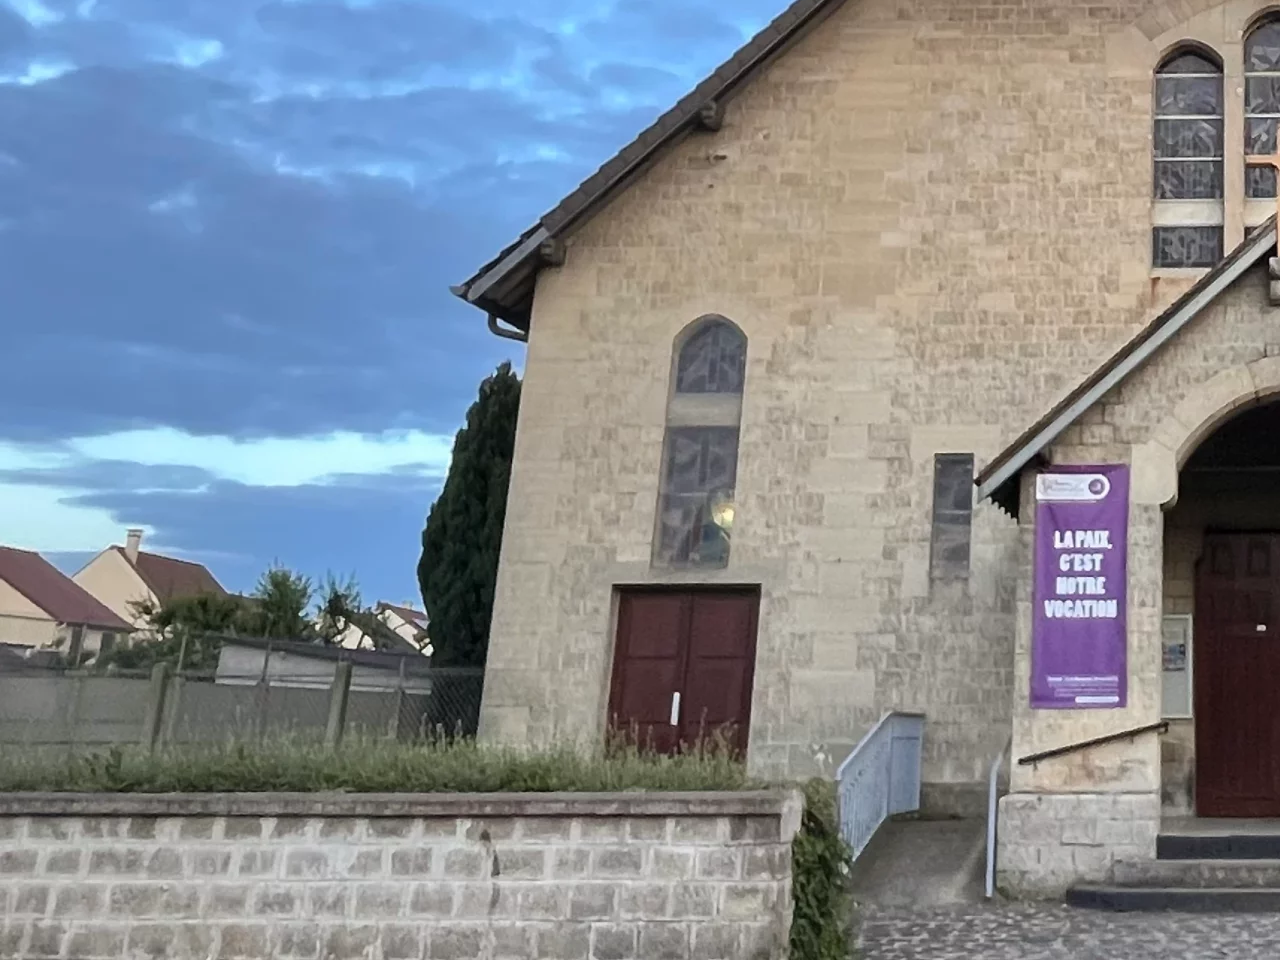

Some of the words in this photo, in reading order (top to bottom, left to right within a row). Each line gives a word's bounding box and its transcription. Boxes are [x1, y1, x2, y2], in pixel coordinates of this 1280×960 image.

[1054, 530, 1074, 549] LA
[1060, 553, 1104, 572] C'EST
[1056, 576, 1106, 595] NOTRE
[1044, 600, 1117, 618] VOCATION
